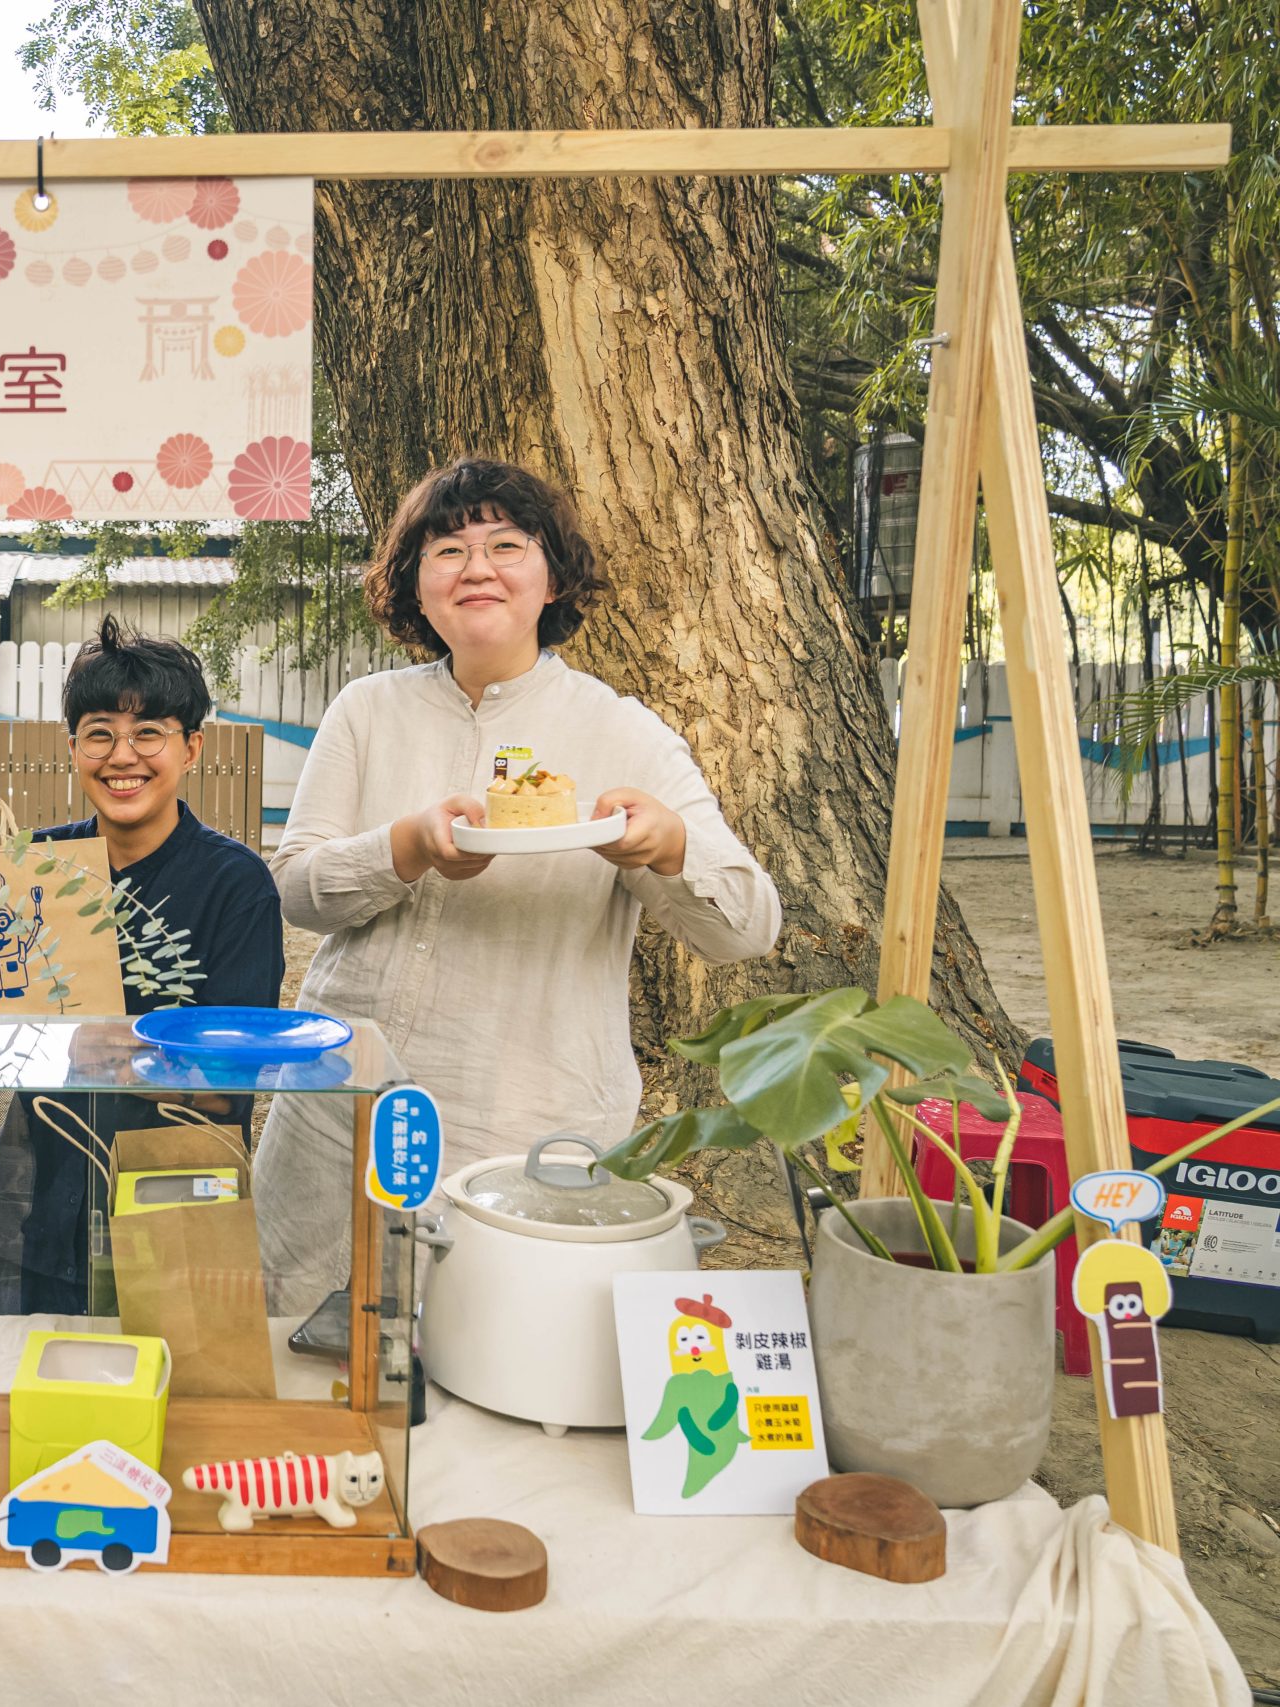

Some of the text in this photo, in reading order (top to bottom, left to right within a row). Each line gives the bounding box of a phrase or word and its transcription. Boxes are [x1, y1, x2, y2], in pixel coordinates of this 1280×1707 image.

[1175, 1162, 1280, 1195] IGLOO
[1093, 1181, 1144, 1209] HEY
[1209, 1209, 1244, 1219] LATITUDE
[755, 1353, 792, 1371] 雞湯
